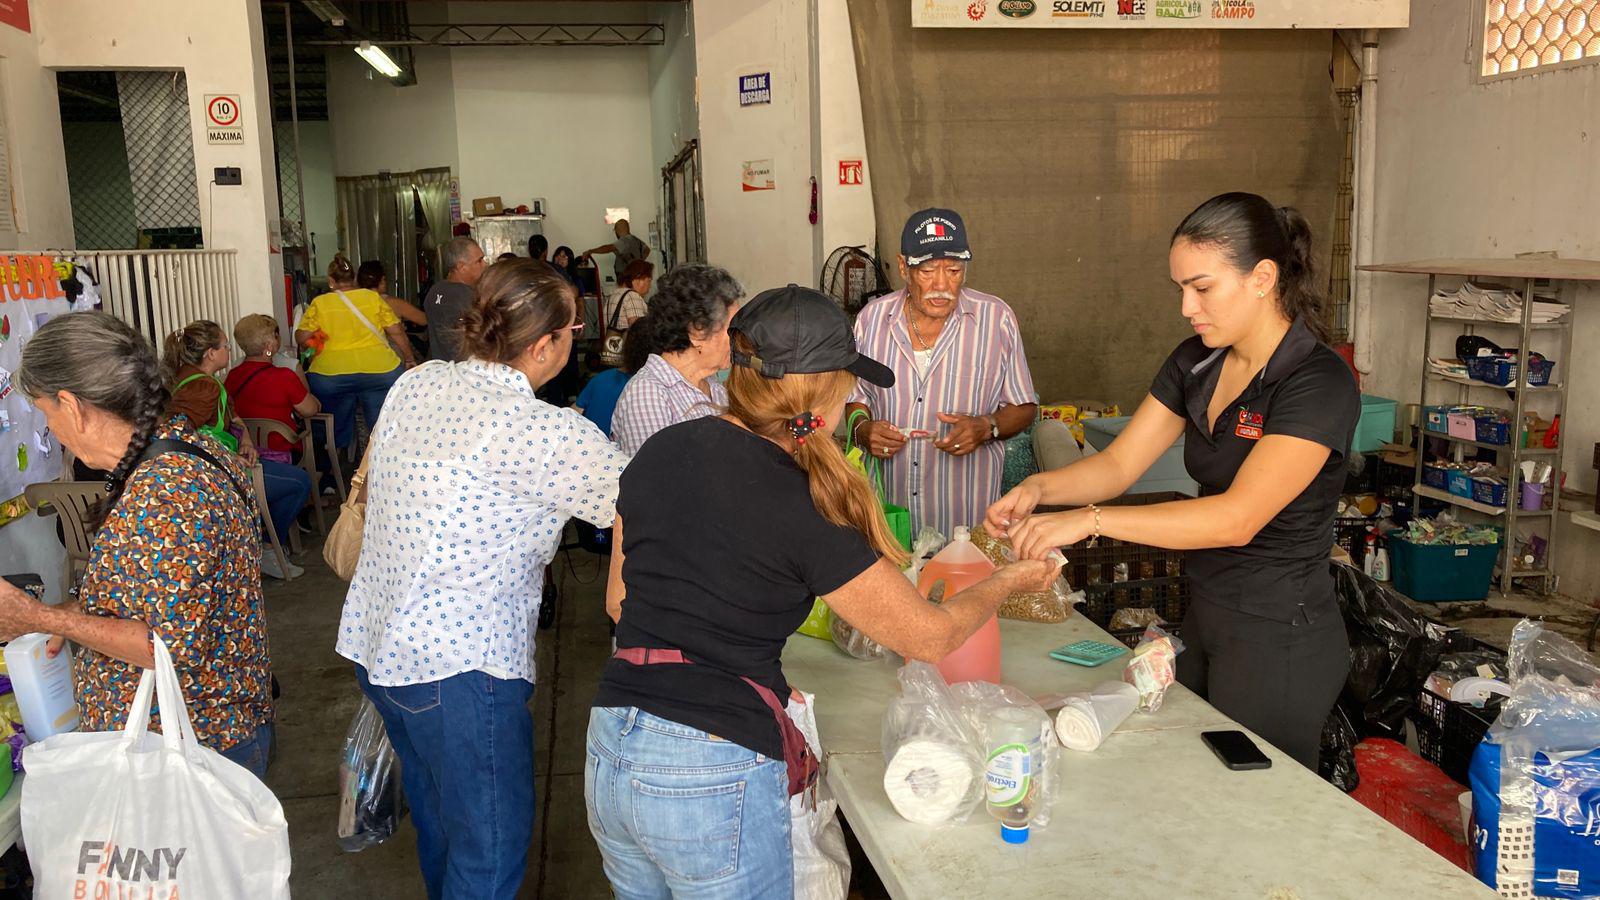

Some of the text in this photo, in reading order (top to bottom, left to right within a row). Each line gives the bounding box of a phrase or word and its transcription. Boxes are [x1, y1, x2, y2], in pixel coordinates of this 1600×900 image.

[1156, 8, 1185, 16] BAJA
[741, 89, 770, 104] DESCARGA
[217, 103, 230, 115] 10
[209, 132, 242, 141] MAXIMA
[914, 218, 933, 234] PILOTOS
[940, 217, 957, 231] PUERTO
[919, 235, 954, 245] MANZANILLO
